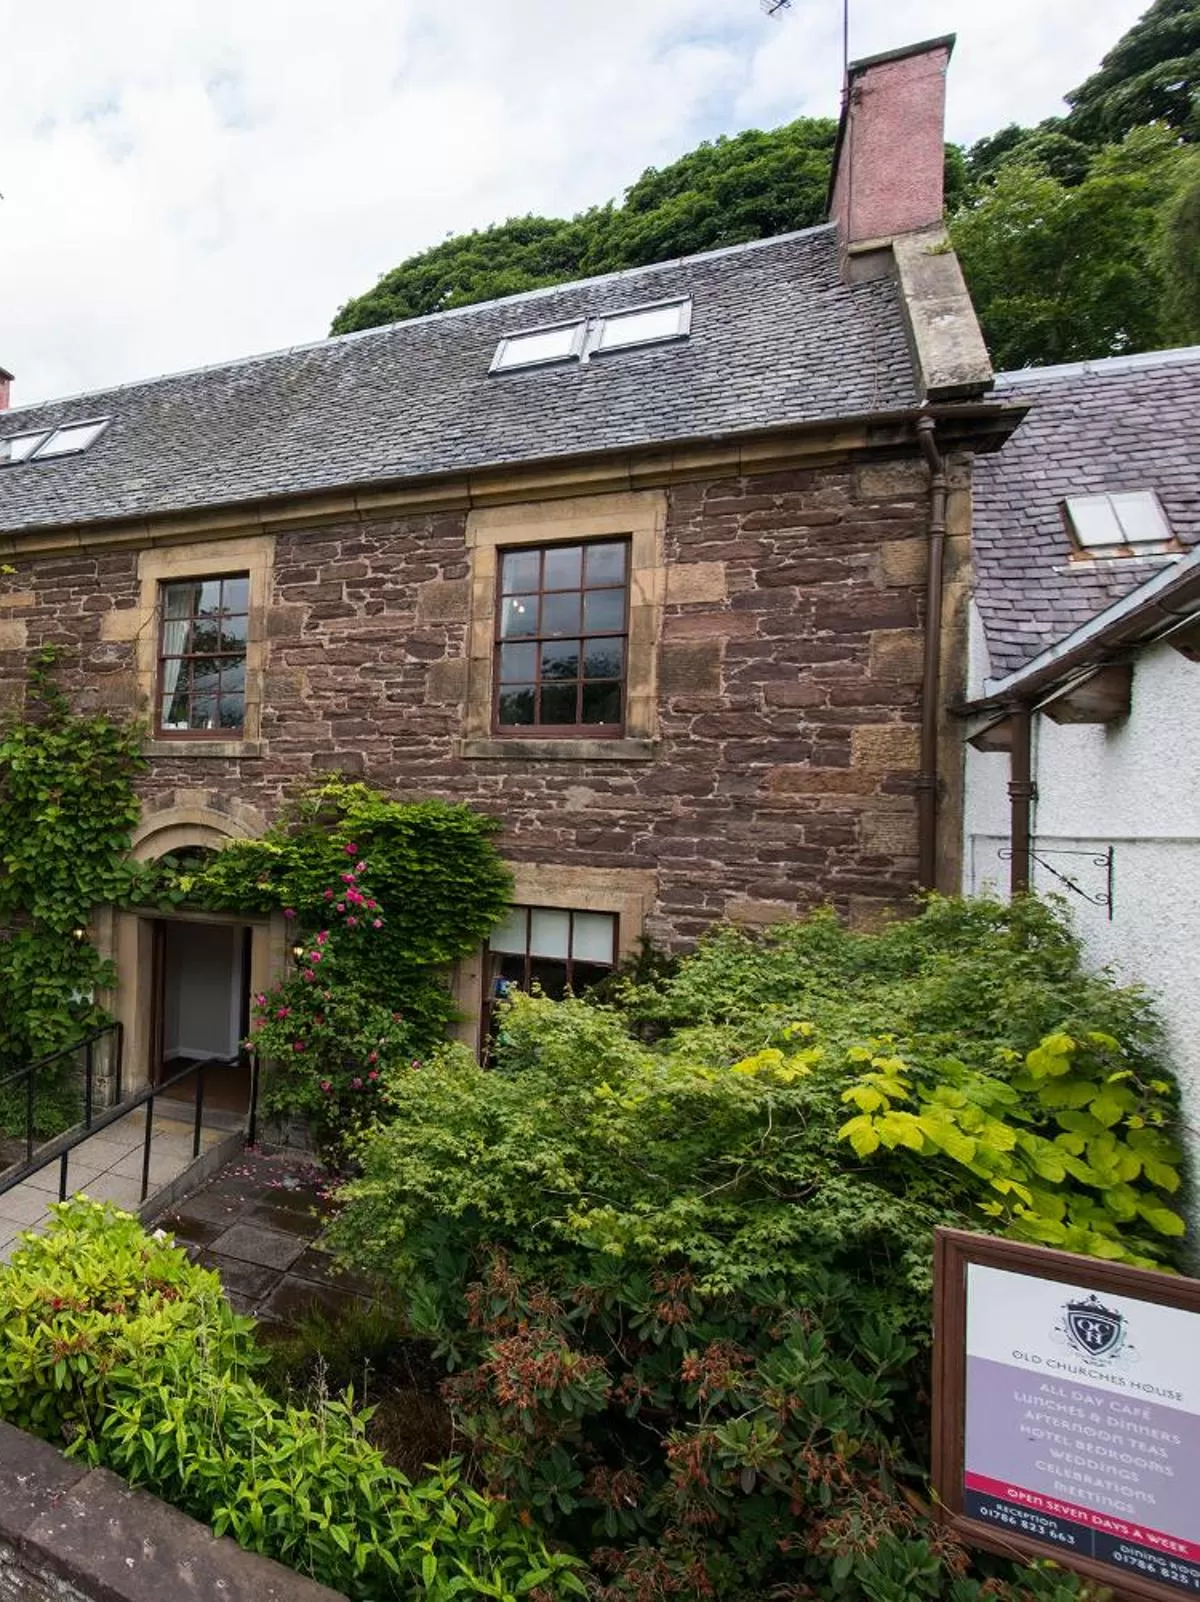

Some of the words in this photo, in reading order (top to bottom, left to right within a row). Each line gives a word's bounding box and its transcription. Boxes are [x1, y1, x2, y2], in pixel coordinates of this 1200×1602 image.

[1012, 1350, 1042, 1364] OLD
[1046, 1358, 1126, 1386] CHURCHES
[1130, 1380, 1184, 1401] HOUSE
[1040, 1383, 1068, 1398] ALL
[1071, 1390, 1104, 1406] DAY
[1014, 1390, 1085, 1418] LUNCHES
[1107, 1415, 1182, 1445] DINNERS
[1024, 1410, 1124, 1446] AFTERNOON
[1129, 1438, 1169, 1459] TEAS
[1020, 1424, 1069, 1446] HOTEL
[1075, 1440, 1174, 1477] BEDROOMS
[1049, 1448, 1140, 1482] WEDDINGS
[1035, 1460, 1156, 1505] CELEBRATIONS
[1054, 1480, 1135, 1514] MEETINGS
[980, 1507, 1017, 1525] 01786
[1020, 1520, 1045, 1535] 823
[1049, 1530, 1075, 1545] 663
[996, 1503, 1058, 1529] RECEPTION
[1007, 1488, 1043, 1506] OPEN
[1046, 1500, 1089, 1520] SEVEN
[1091, 1515, 1129, 1535] DAYS
[1132, 1529, 1143, 1540] A
[1146, 1533, 1189, 1555] WEEK
[1113, 1550, 1156, 1573] 01786
[1119, 1544, 1167, 1567] DINING
